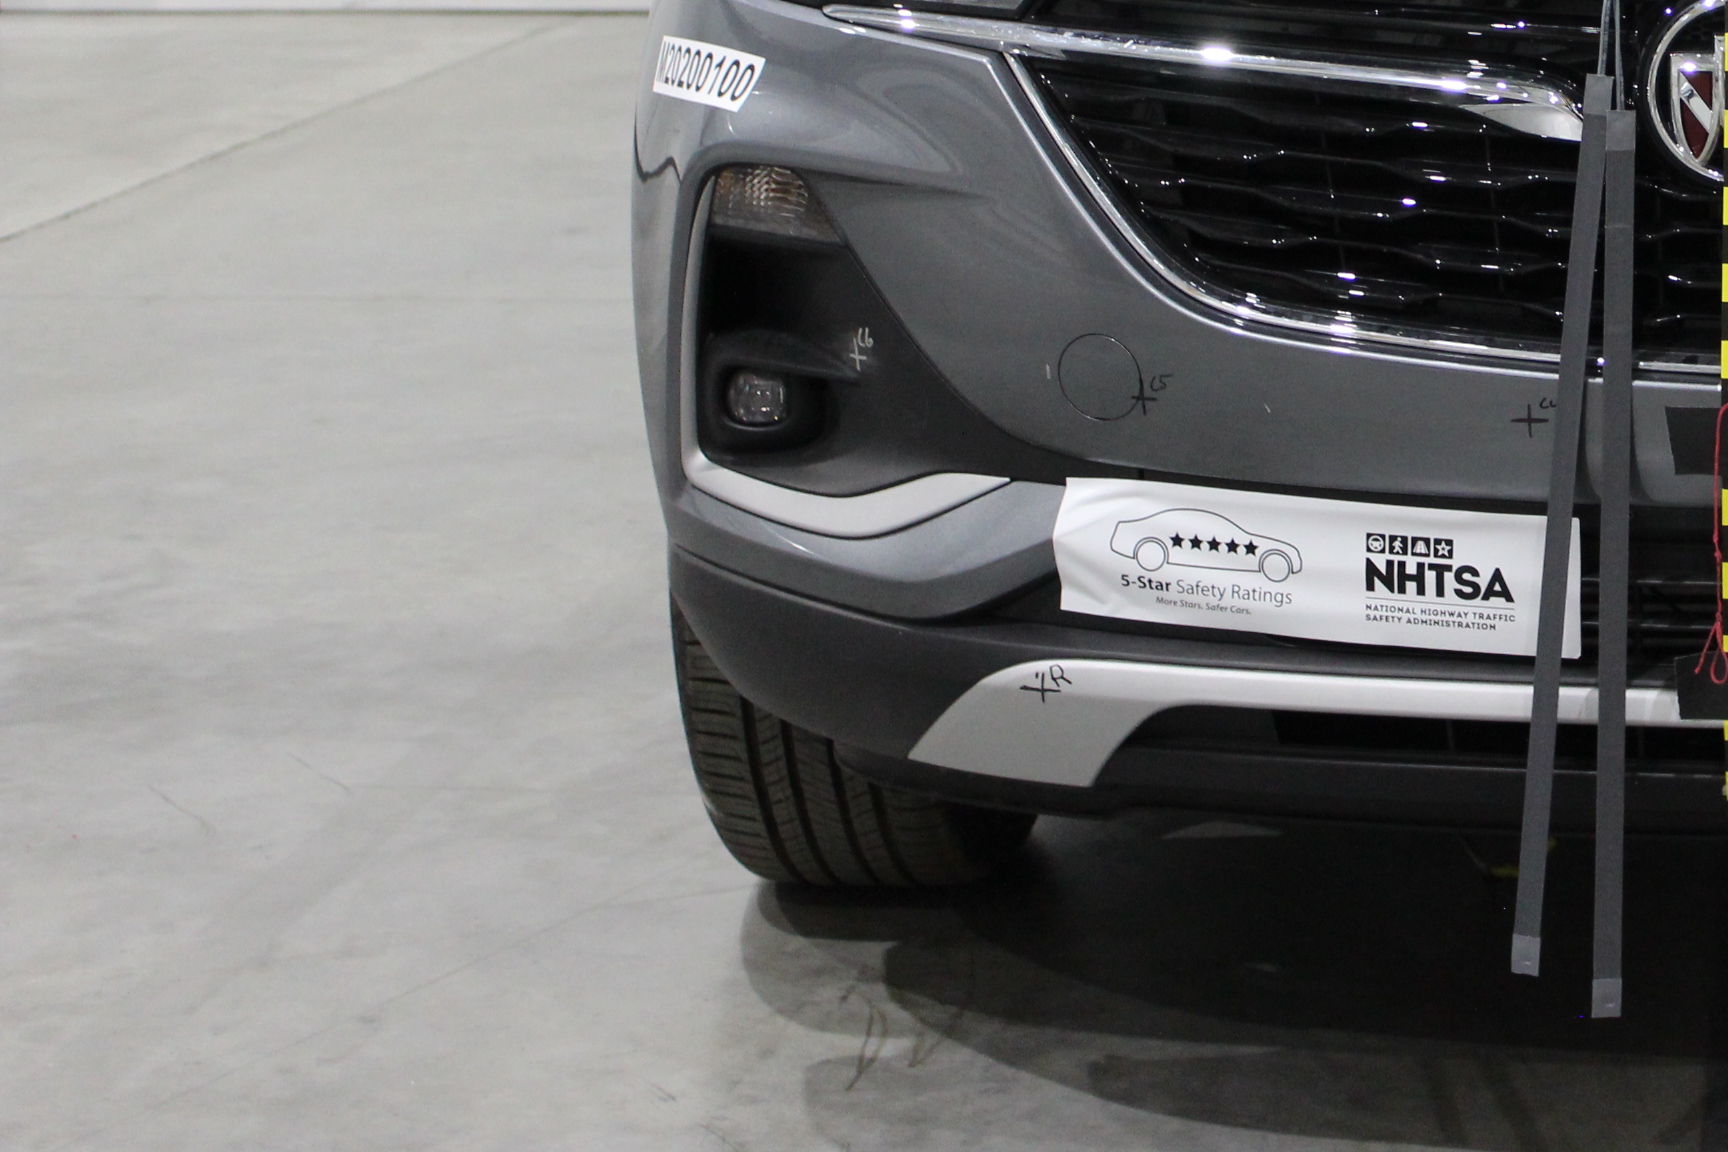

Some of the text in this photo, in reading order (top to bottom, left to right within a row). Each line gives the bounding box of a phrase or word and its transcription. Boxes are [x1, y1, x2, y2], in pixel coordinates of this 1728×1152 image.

[1365, 557, 1515, 603] NHTSA
[1120, 574, 1293, 608] 5-Star Safety Ratings
[1155, 596, 1252, 615] More Stars. Safer Cars.
[1365, 603, 1516, 622] NATIONAL HIGHWAY TRAFFIC
[1365, 613, 1497, 631] SAFETY ADMINISTRATION
